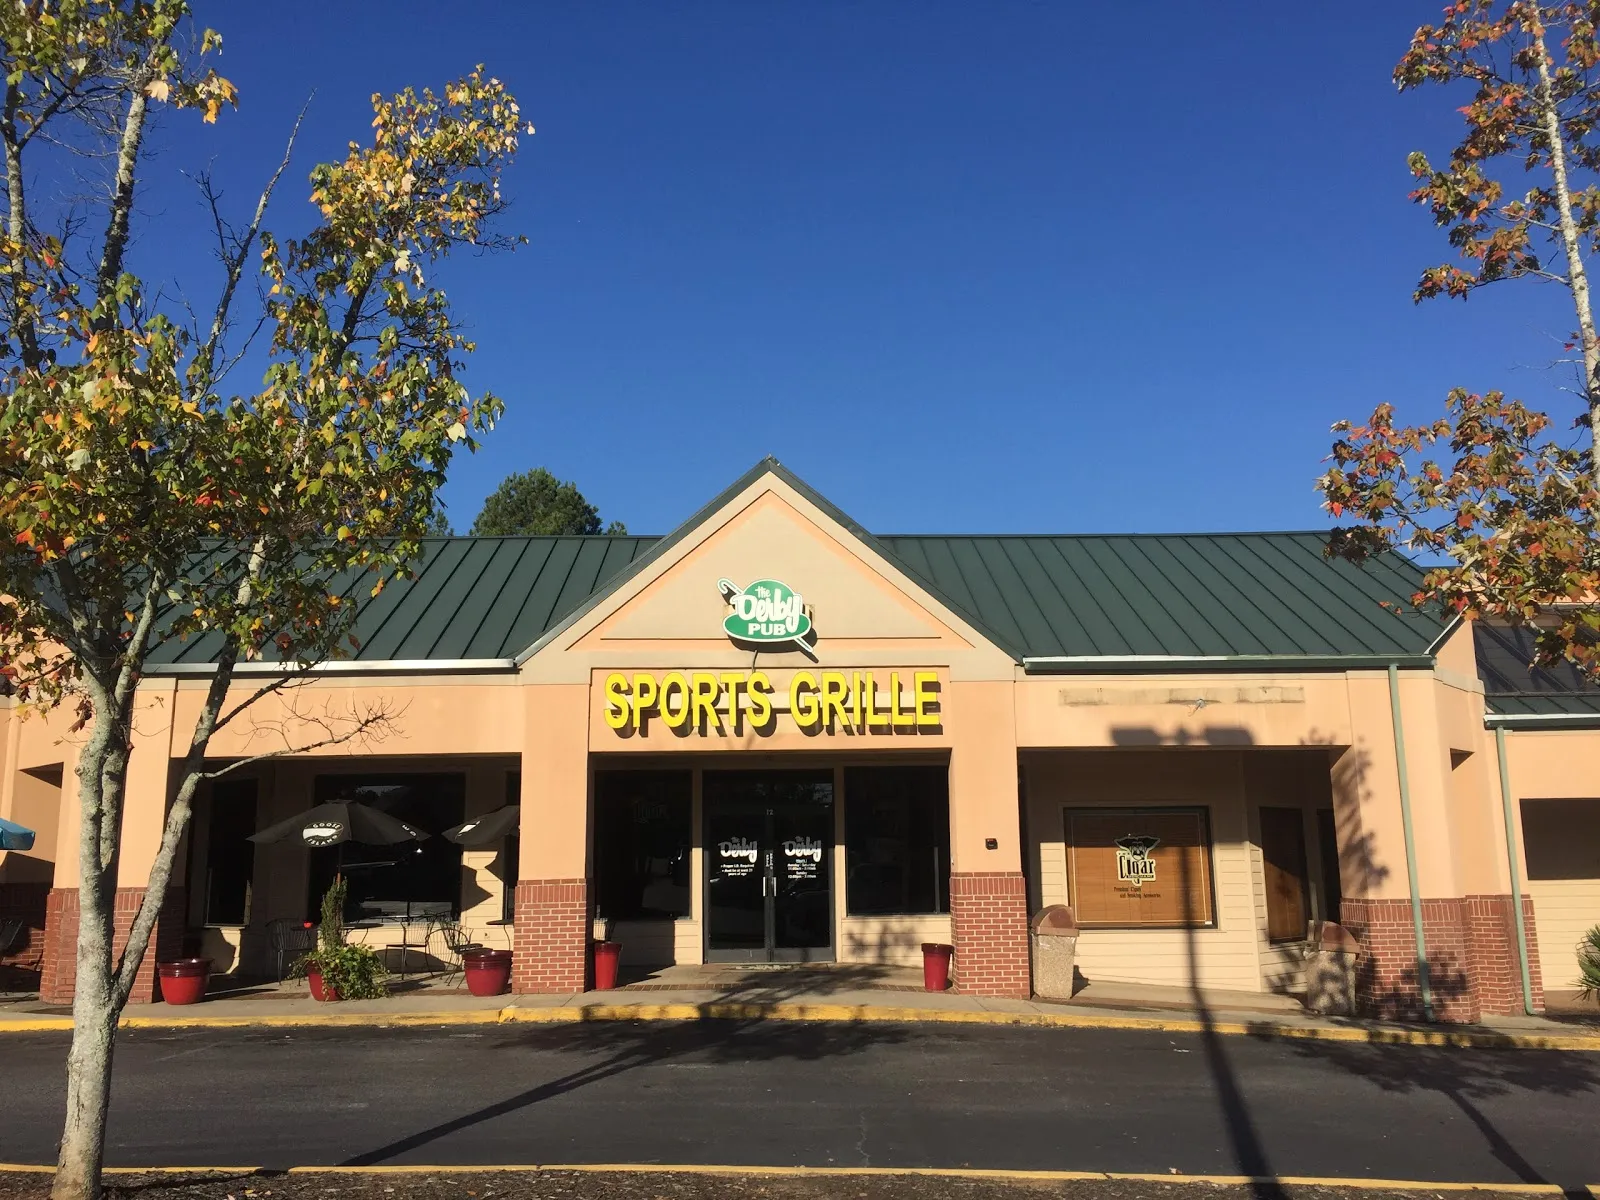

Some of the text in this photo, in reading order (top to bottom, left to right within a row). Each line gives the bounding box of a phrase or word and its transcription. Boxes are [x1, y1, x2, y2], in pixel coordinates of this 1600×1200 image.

[755, 586, 771, 598] the
[730, 588, 802, 633] Derby
[747, 623, 787, 636] PUB
[603, 671, 940, 729] SPORTS GRILLE
[312, 822, 341, 830] GOOSE
[307, 834, 338, 846] ISLAND
[717, 837, 758, 863] Derby
[781, 836, 822, 862] Derby
[1119, 855, 1154, 885] Cigar
